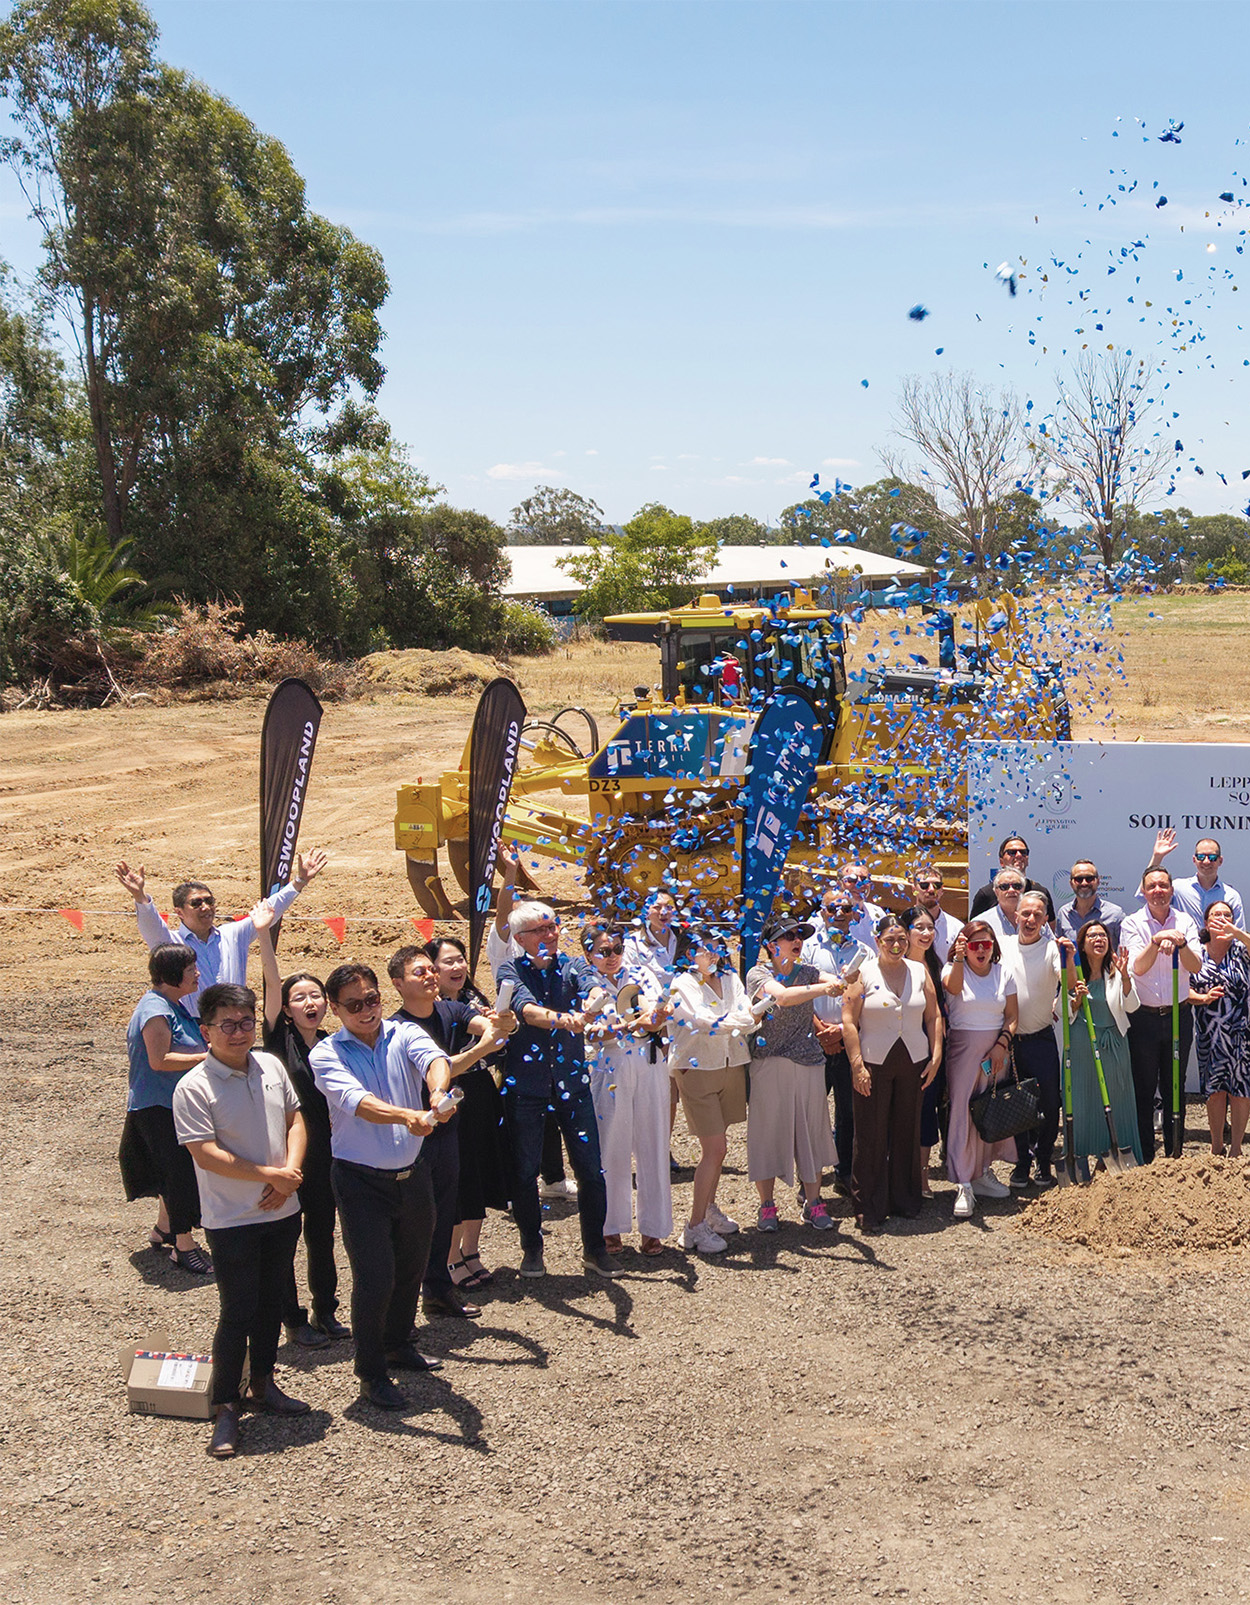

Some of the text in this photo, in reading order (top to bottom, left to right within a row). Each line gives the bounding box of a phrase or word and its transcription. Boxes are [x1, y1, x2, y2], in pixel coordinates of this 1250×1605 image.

[589, 779, 621, 792] DZ3
[277, 720, 314, 880] SWOOPLAND
[1128, 813, 1176, 829] SOIL
